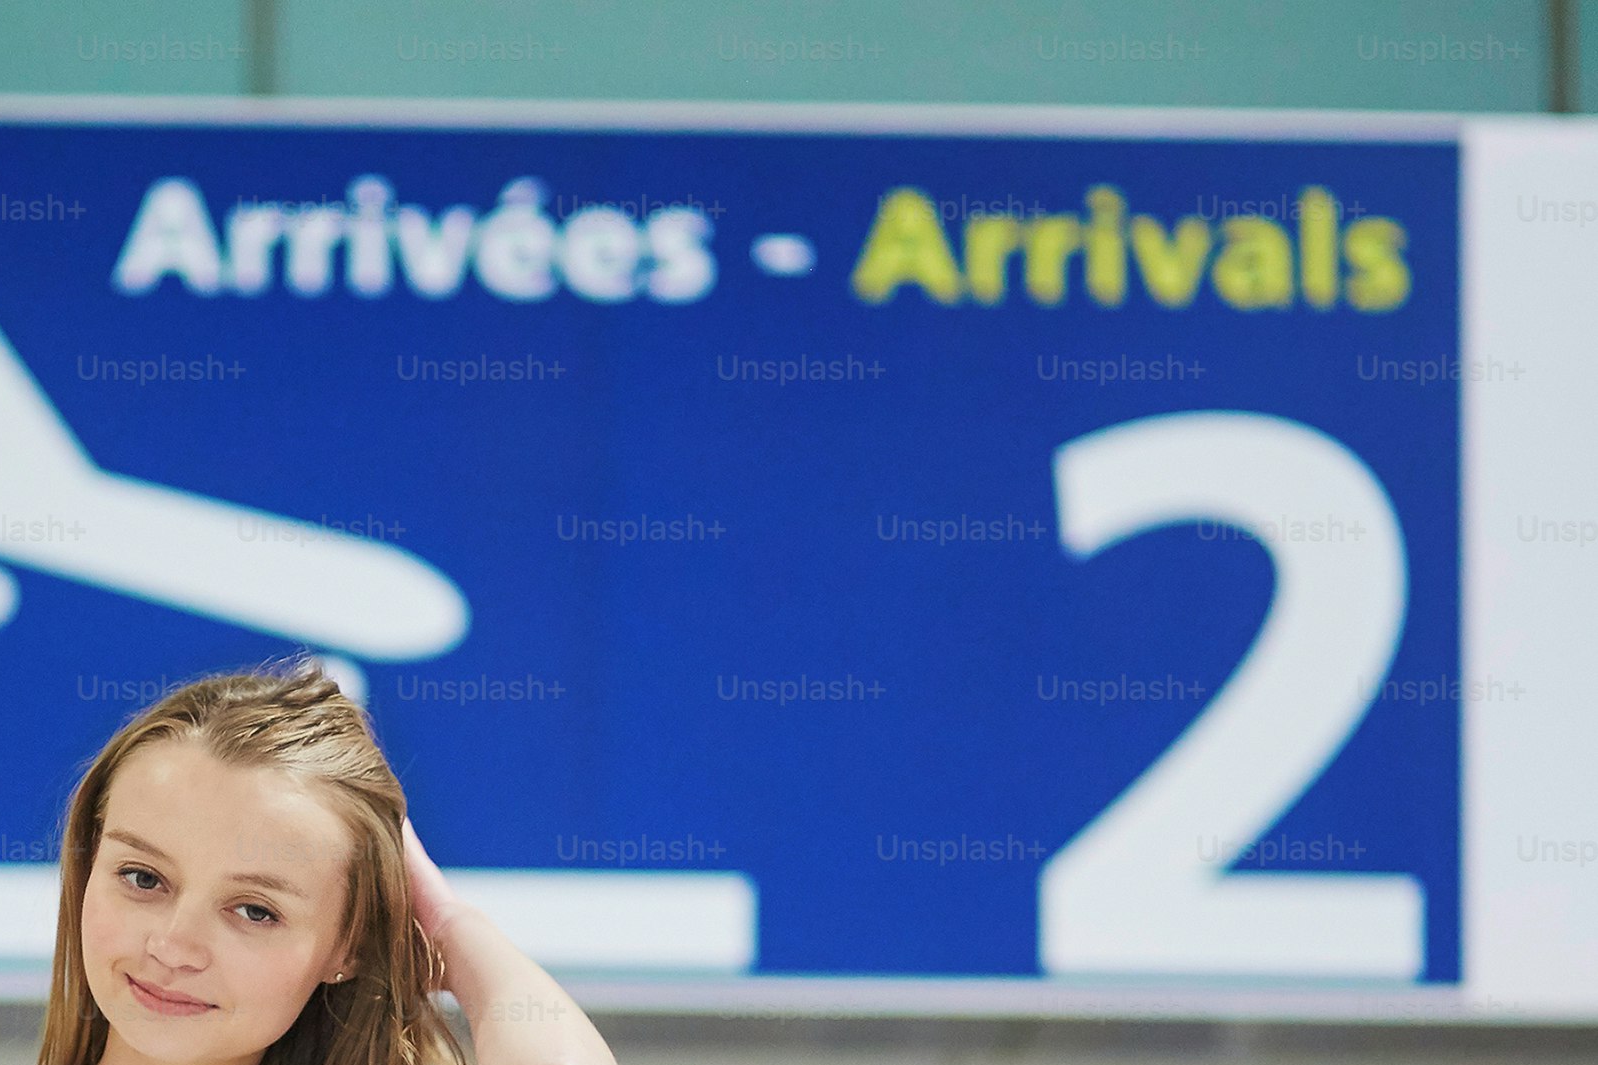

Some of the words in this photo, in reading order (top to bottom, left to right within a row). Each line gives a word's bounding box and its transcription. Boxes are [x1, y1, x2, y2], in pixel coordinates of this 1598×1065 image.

[115, 177, 715, 302] Arrivées
[752, 235, 814, 275] -
[851, 185, 1411, 311] Arrivals
[1038, 411, 1426, 980] 2
